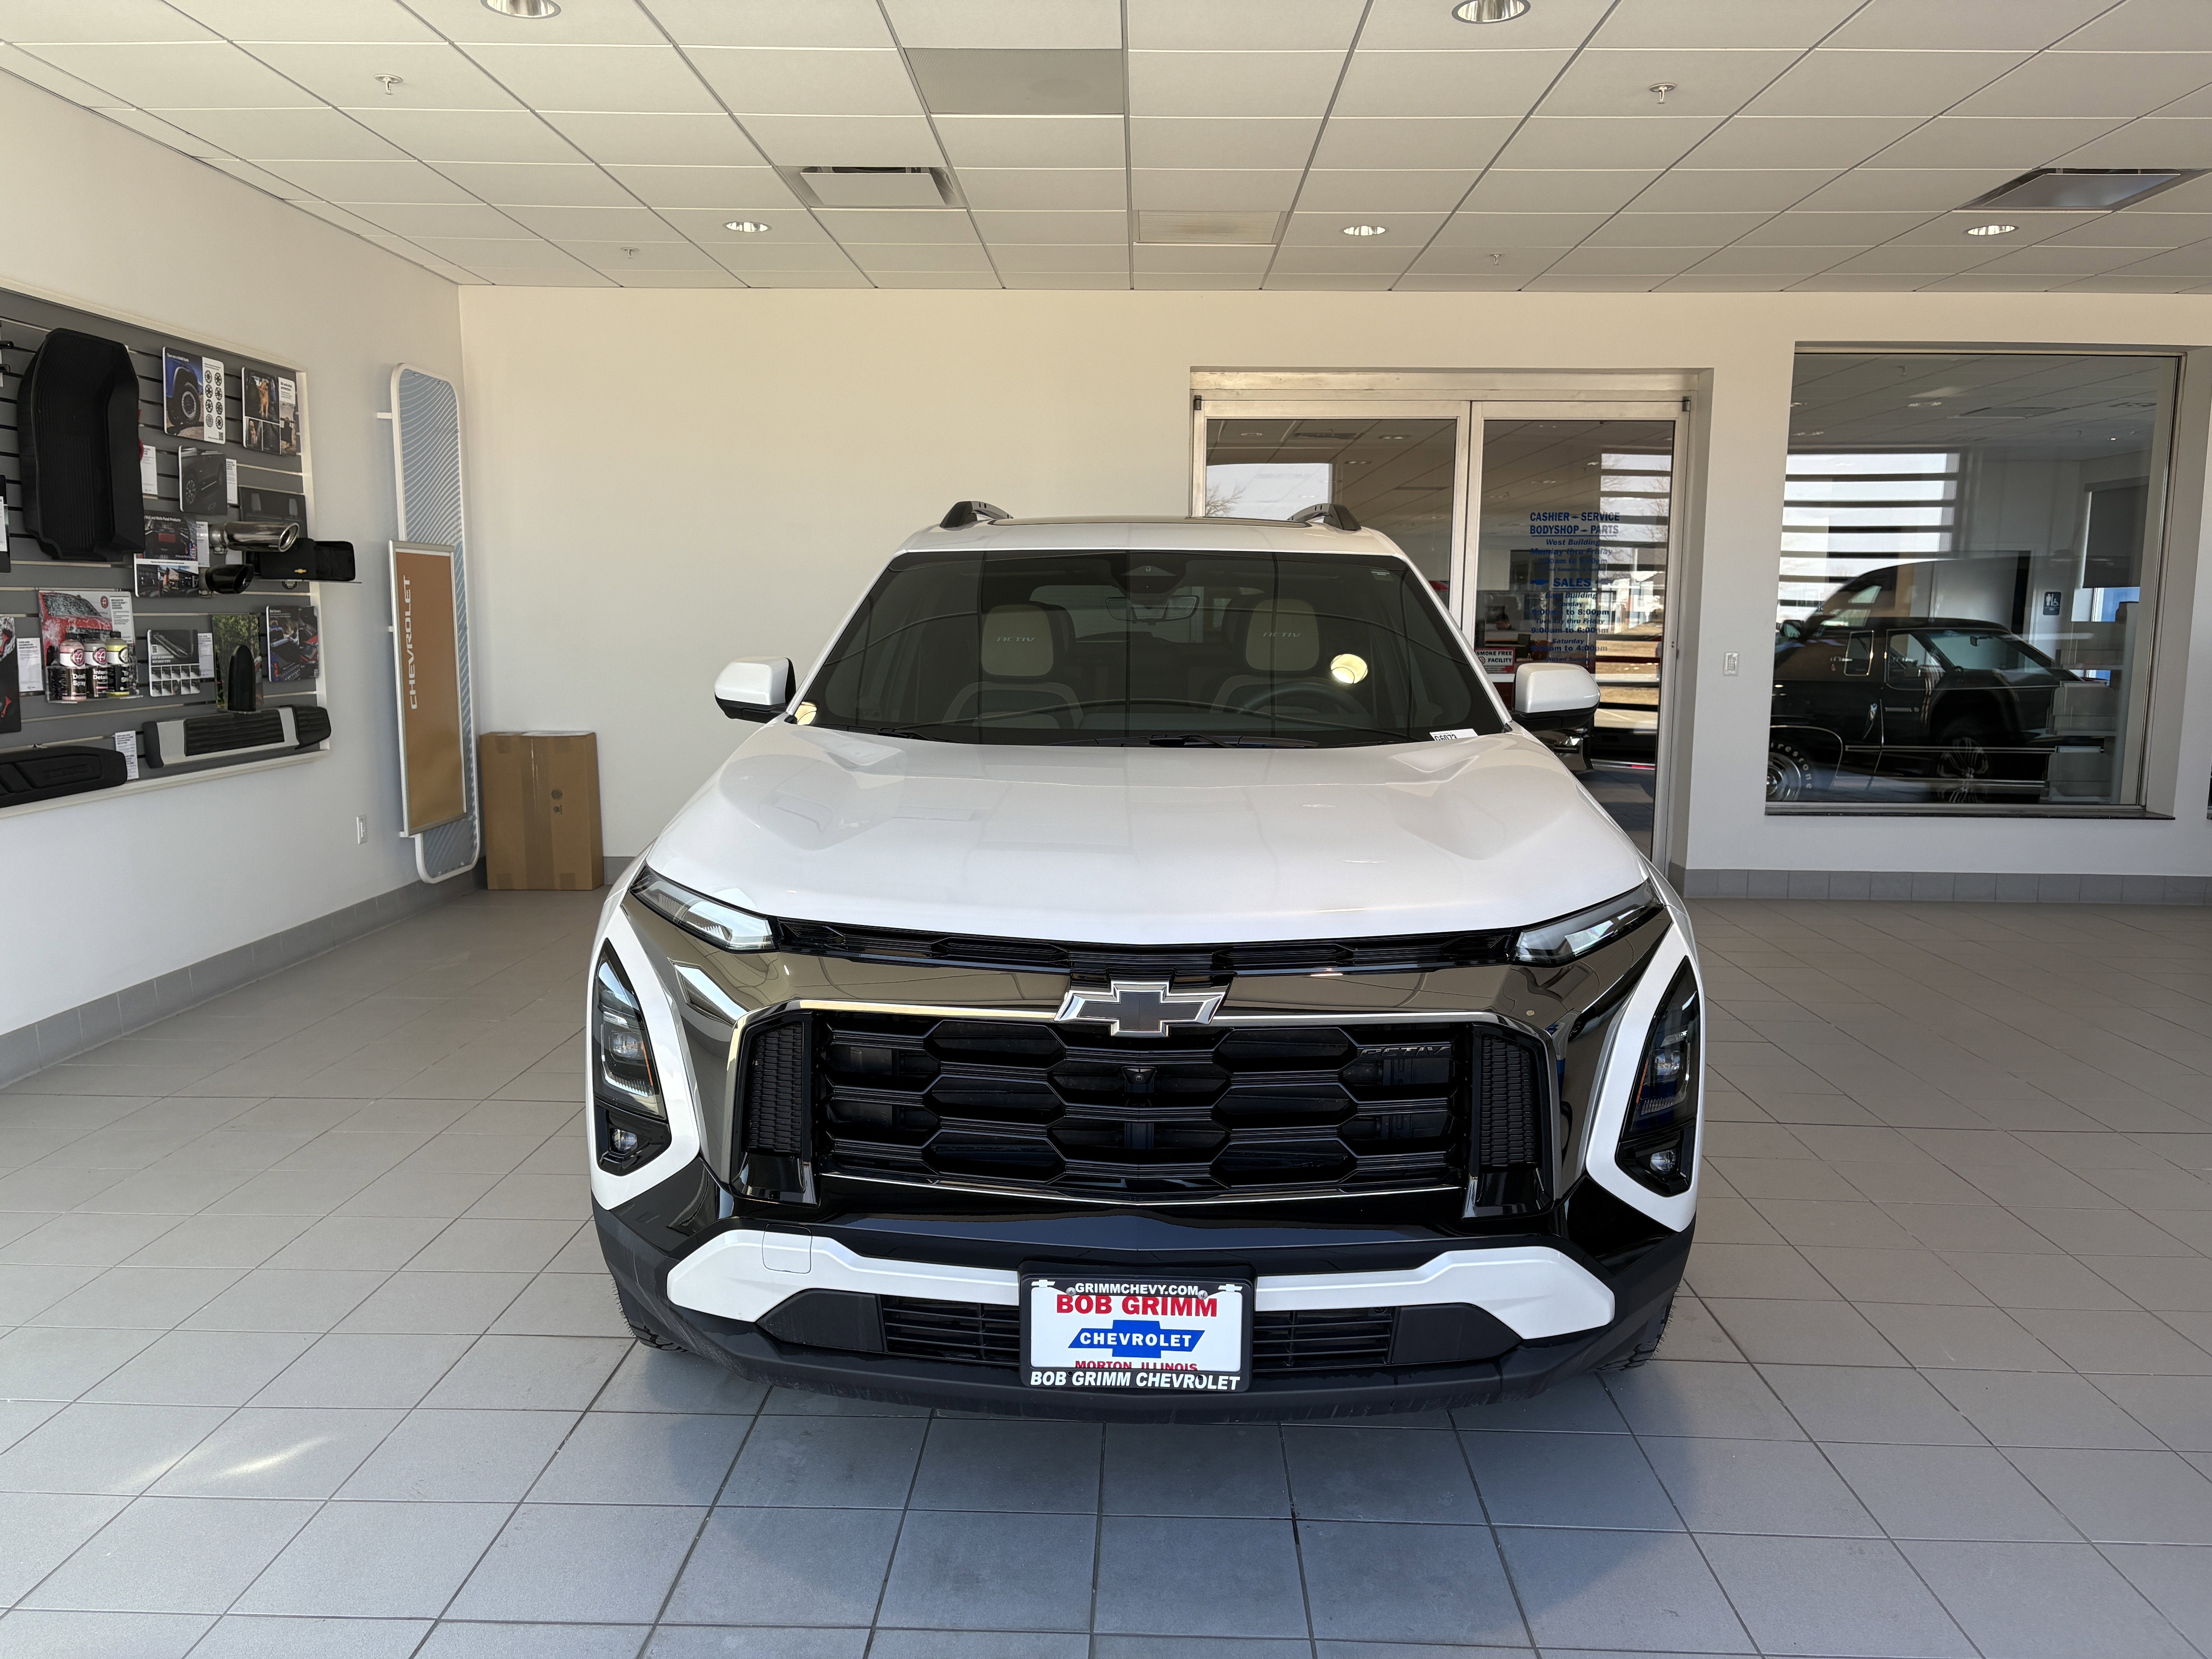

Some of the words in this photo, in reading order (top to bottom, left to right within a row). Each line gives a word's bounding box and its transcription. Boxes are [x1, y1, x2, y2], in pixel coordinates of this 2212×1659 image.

[1530, 512, 1570, 521] CASHIER
[1581, 512, 1620, 521] SERVICE
[1530, 525, 1579, 534] BODYSHOP
[1590, 525, 1619, 534] PARTS
[1568, 539, 1601, 547] Building
[1553, 578, 1591, 587] SALES
[404, 575, 417, 709] CHEVROLET
[1075, 1283, 1199, 1296] GRIMMCHEVY.COM
[1056, 1294, 1112, 1314] BOB
[1122, 1296, 1218, 1317] GRIMM
[1080, 1332, 1192, 1348] CHEVROLET
[1075, 1360, 1132, 1370] MORTON
[1141, 1362, 1198, 1371] ILLINOIS
[1030, 1371, 1067, 1386] BOB
[1071, 1371, 1131, 1387] GRIMM
[1135, 1373, 1241, 1391] CHEVROLET
